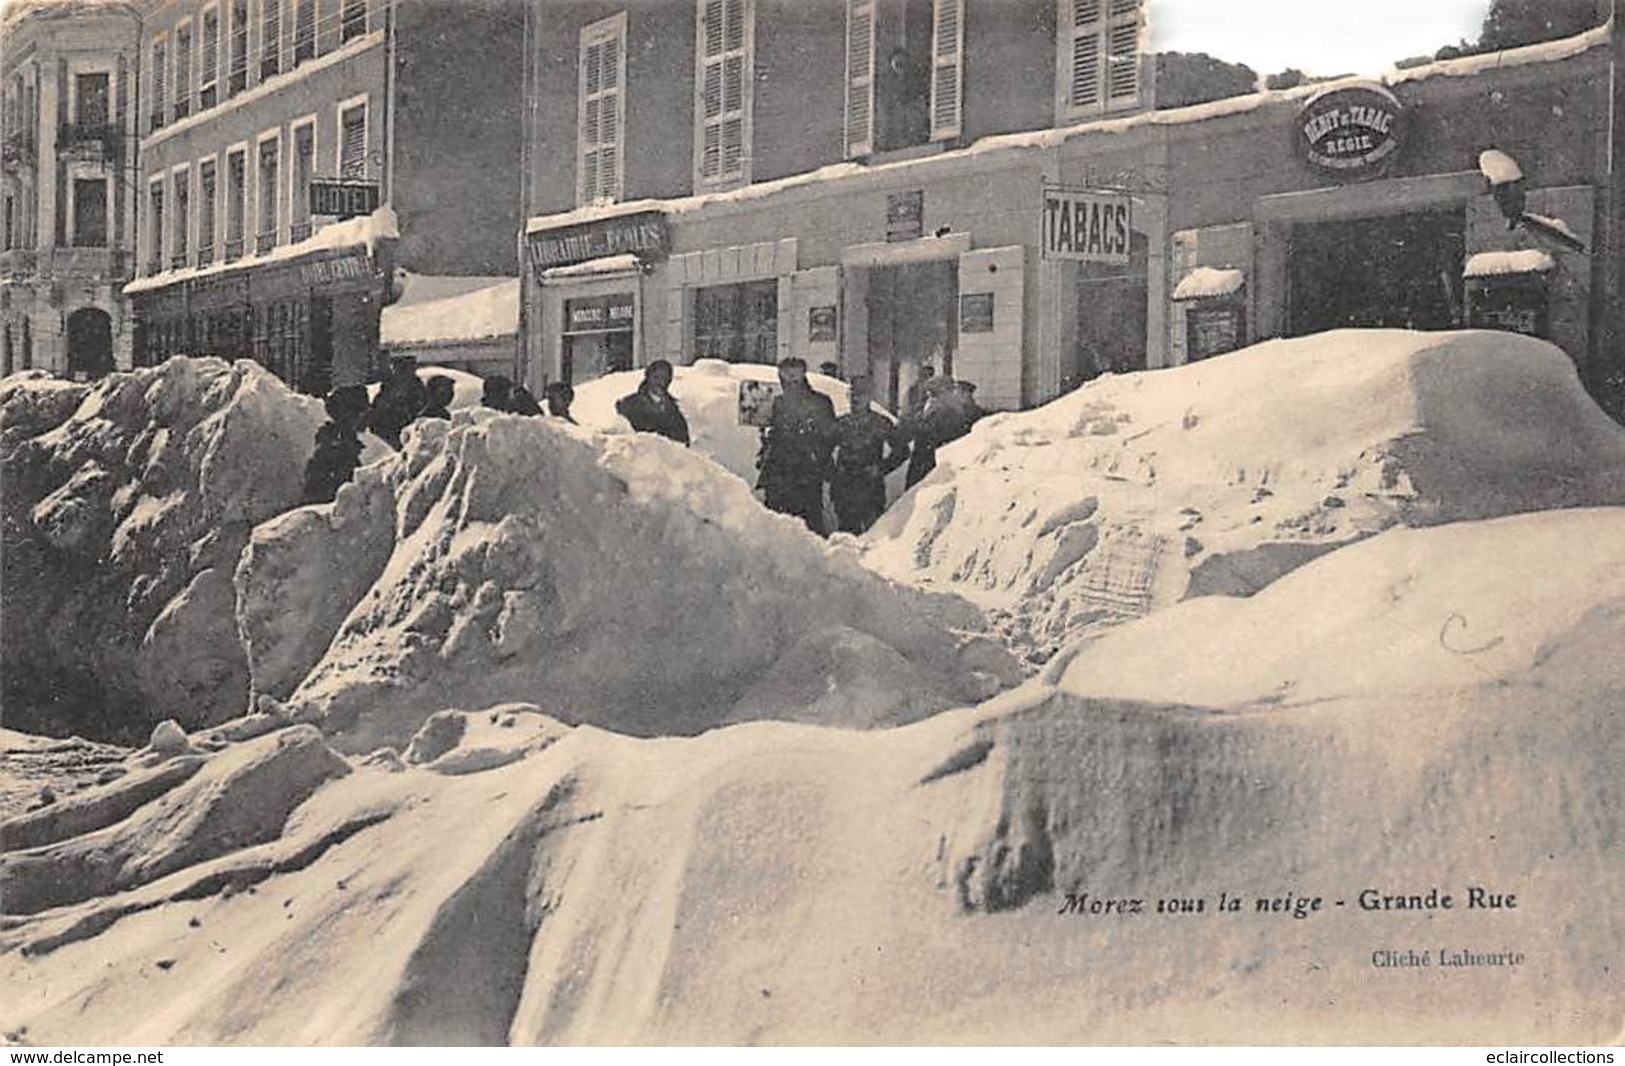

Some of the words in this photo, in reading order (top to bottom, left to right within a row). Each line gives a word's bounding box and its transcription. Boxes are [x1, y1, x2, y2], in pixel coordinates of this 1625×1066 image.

[1349, 105, 1395, 134] TABAC
[315, 186, 371, 213] HOTEL
[1045, 198, 1127, 255] TABACS
